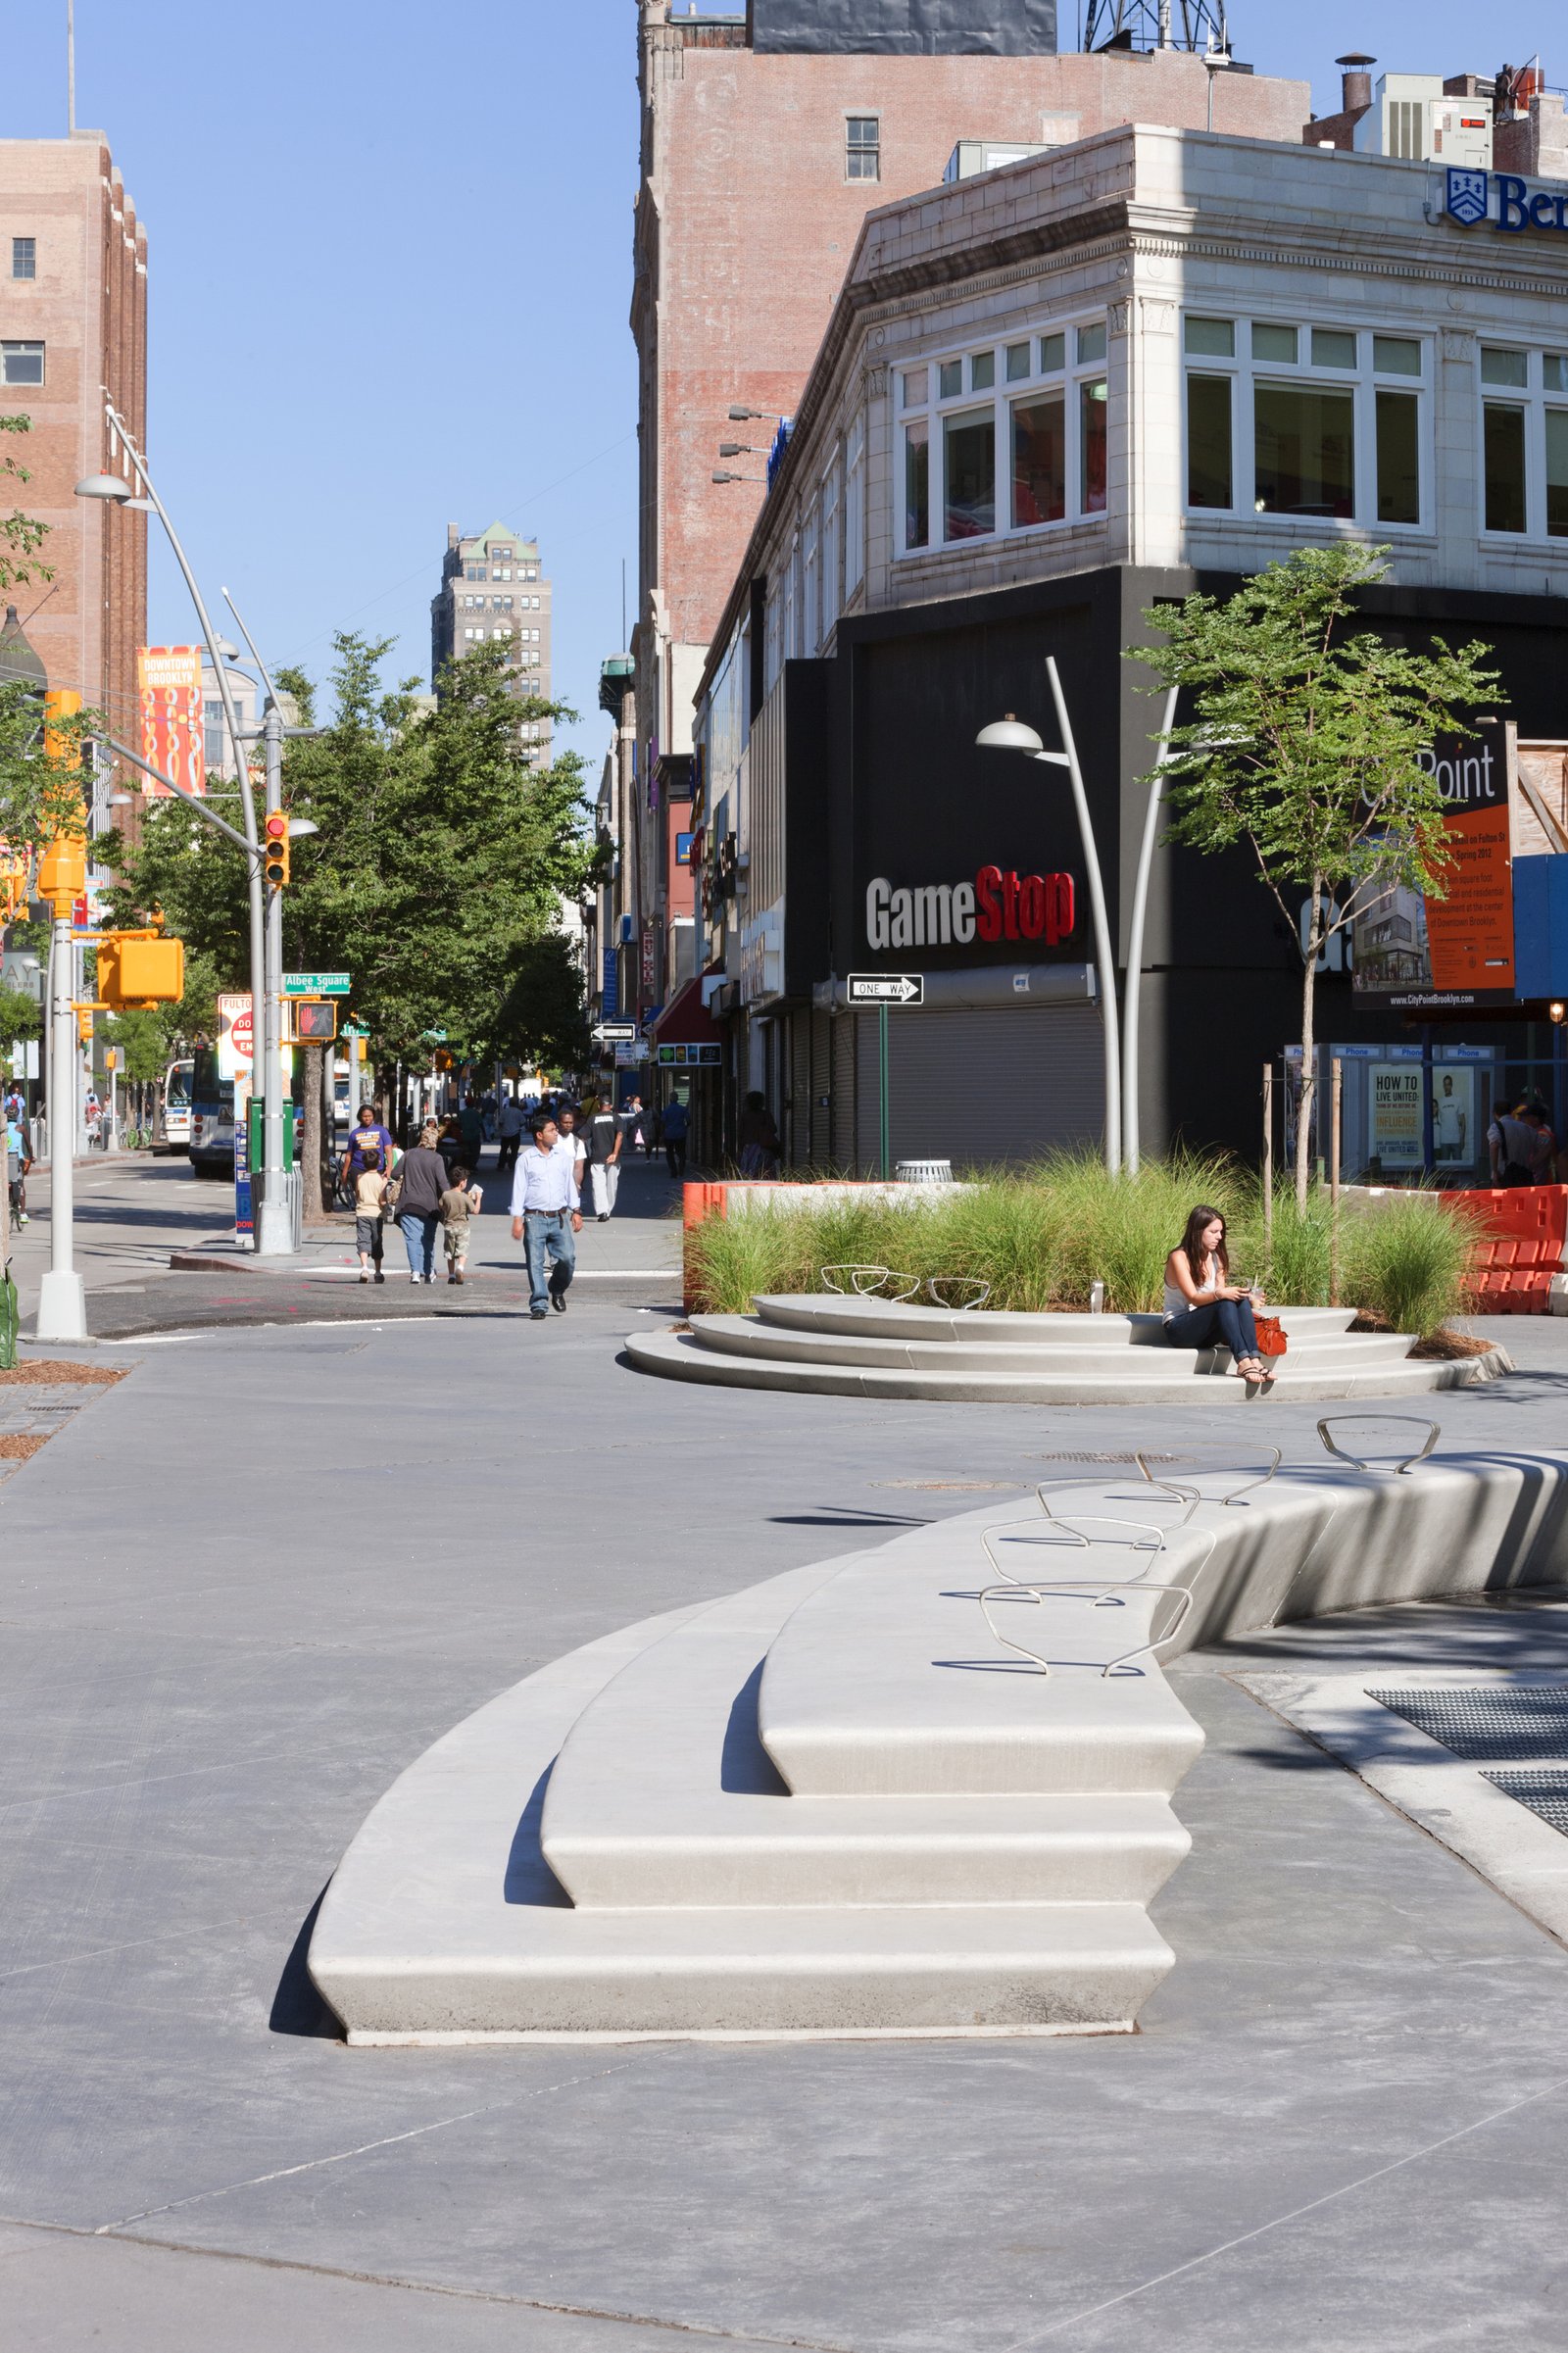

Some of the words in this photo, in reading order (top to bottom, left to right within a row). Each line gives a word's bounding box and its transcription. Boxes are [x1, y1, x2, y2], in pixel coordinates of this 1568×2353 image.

[144, 658, 195, 671] DOWNTOWN
[147, 671, 193, 685] BROOKLYN
[1478, 833, 1498, 843] Fulton
[1498, 832, 1505, 842] St
[1456, 850, 1477, 861] Spring
[1477, 848, 1492, 858] 2012
[1459, 876, 1479, 886] square
[1480, 873, 1494, 882] foot
[1461, 888, 1472, 899] and
[1473, 886, 1505, 897] residential
[865, 864, 1074, 951] GameStop
[1428, 903, 1466, 915] development
[1473, 903, 1485, 911] the
[1485, 902, 1504, 911] center
[1438, 916, 1469, 928] Downtown
[644, 940, 654, 956] BUY
[644, 960, 654, 984] GOLD
[286, 975, 314, 986] Albee
[317, 974, 350, 988] Square
[305, 984, 326, 994] West
[858, 983, 880, 995] ONE
[889, 984, 911, 996] WAY
[1390, 993, 1474, 1007] www.CityPointBrooklyn.com
[238, 1019, 252, 1029] DO
[1346, 1046, 1369, 1056] Phone
[1457, 1048, 1480, 1057] Phone
[1376, 1075, 1401, 1091] HOW
[1404, 1075, 1418, 1091] TO
[1376, 1092, 1392, 1102] LIVE
[1393, 1091, 1419, 1102] UNITED:
[1376, 1115, 1418, 1128] INFLUENCE
